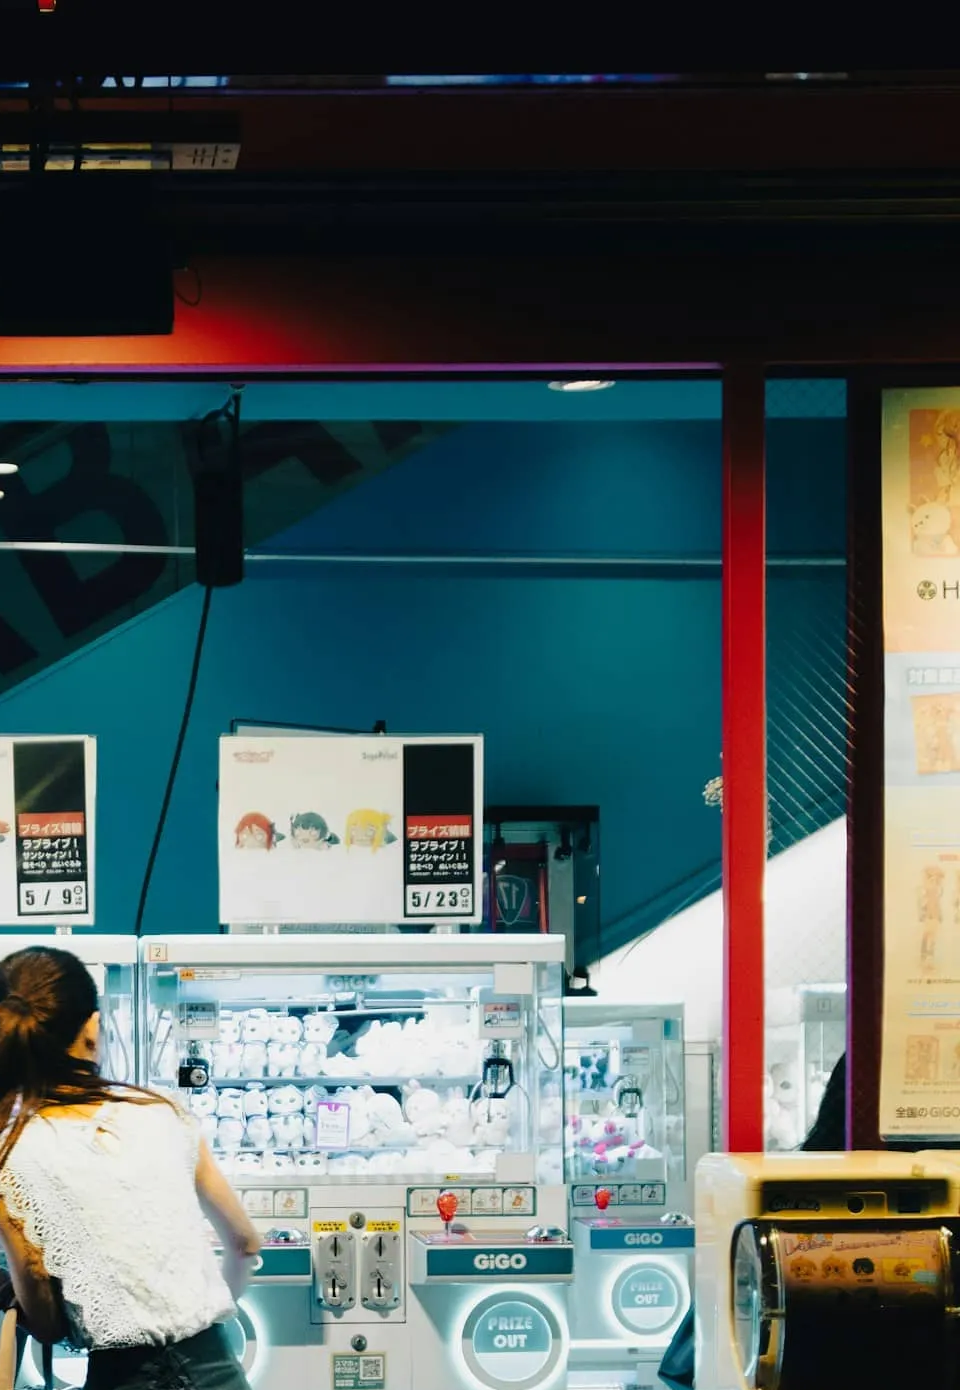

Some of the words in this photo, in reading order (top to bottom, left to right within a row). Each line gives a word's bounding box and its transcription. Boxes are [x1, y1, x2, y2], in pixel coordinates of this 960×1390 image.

[624, 1232, 663, 1246] GiGO
[473, 1253, 527, 1270] GiGO
[488, 1316, 533, 1331] PRIZE
[493, 1334, 528, 1349] OUT
